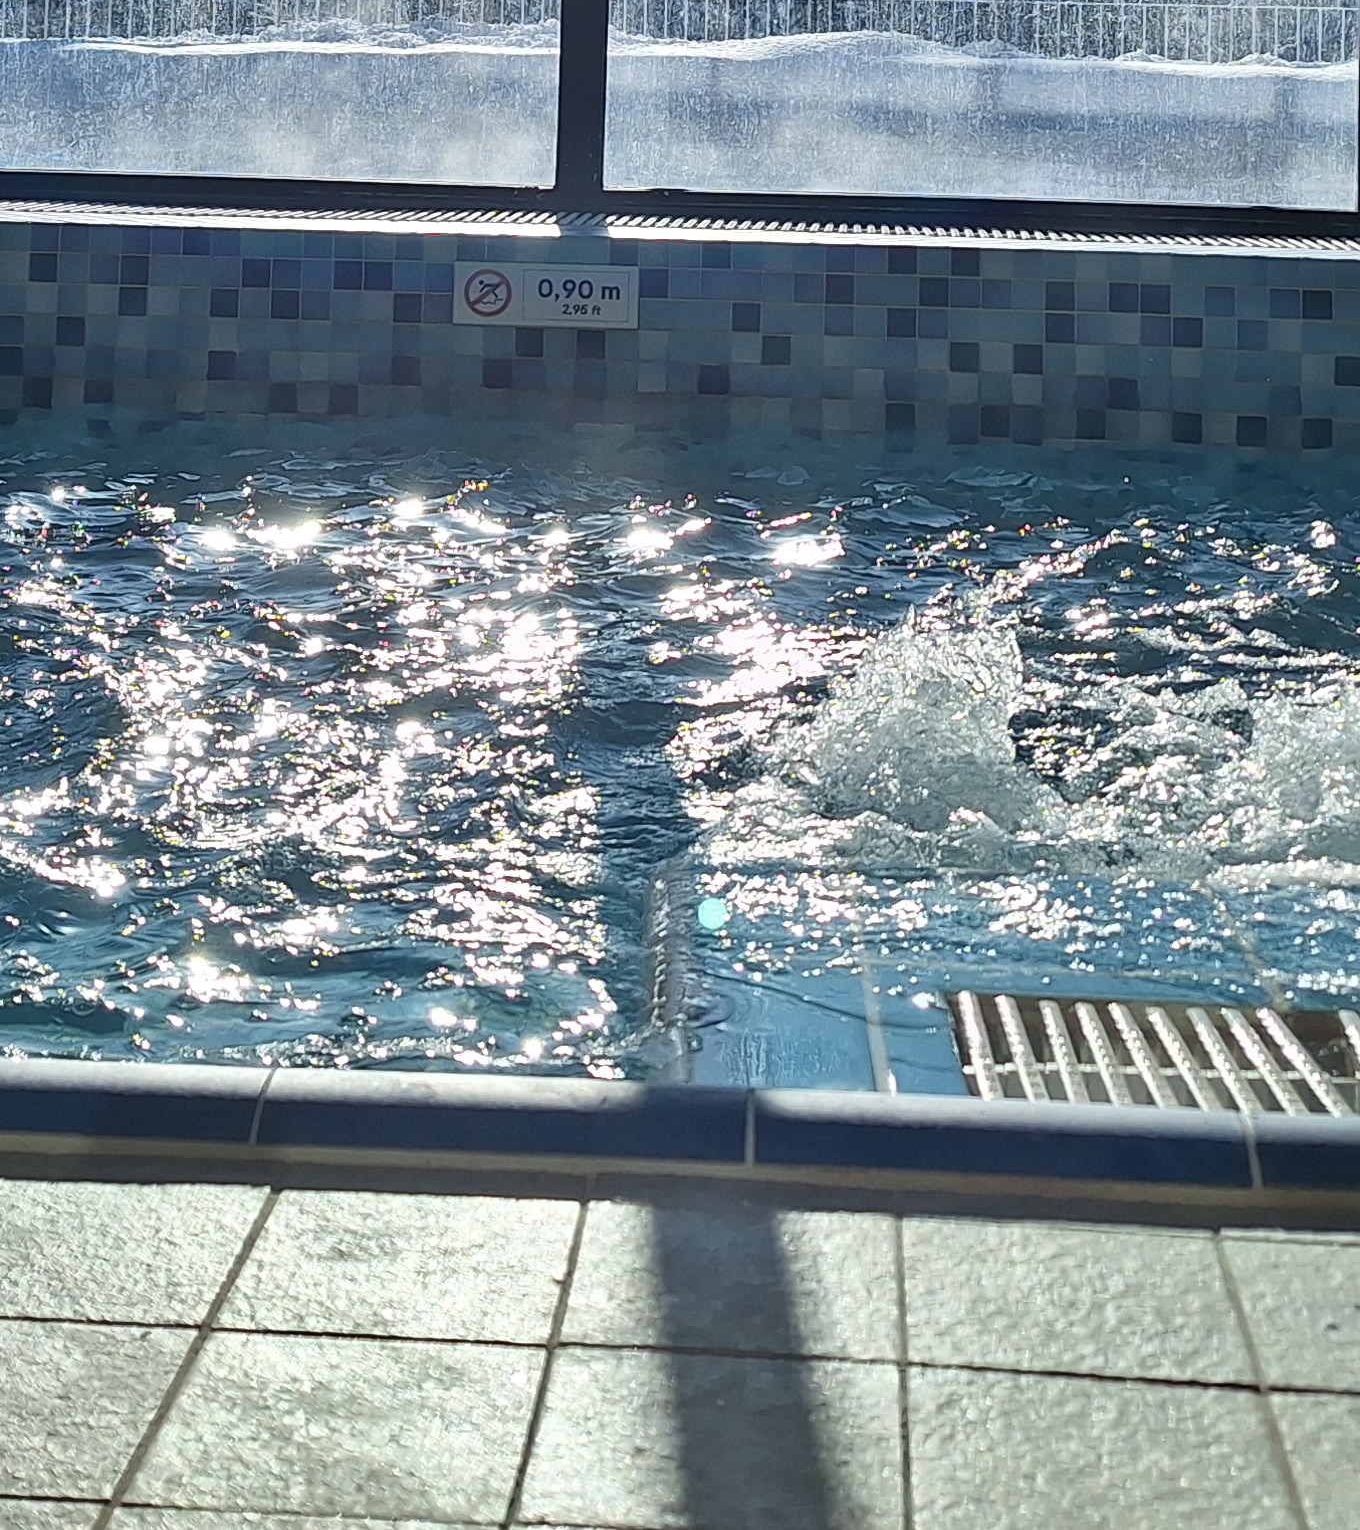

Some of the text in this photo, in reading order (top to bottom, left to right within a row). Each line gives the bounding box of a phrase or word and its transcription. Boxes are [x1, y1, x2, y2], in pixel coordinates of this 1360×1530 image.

[537, 278, 621, 303] 0,90 m
[591, 304, 602, 316] ft
